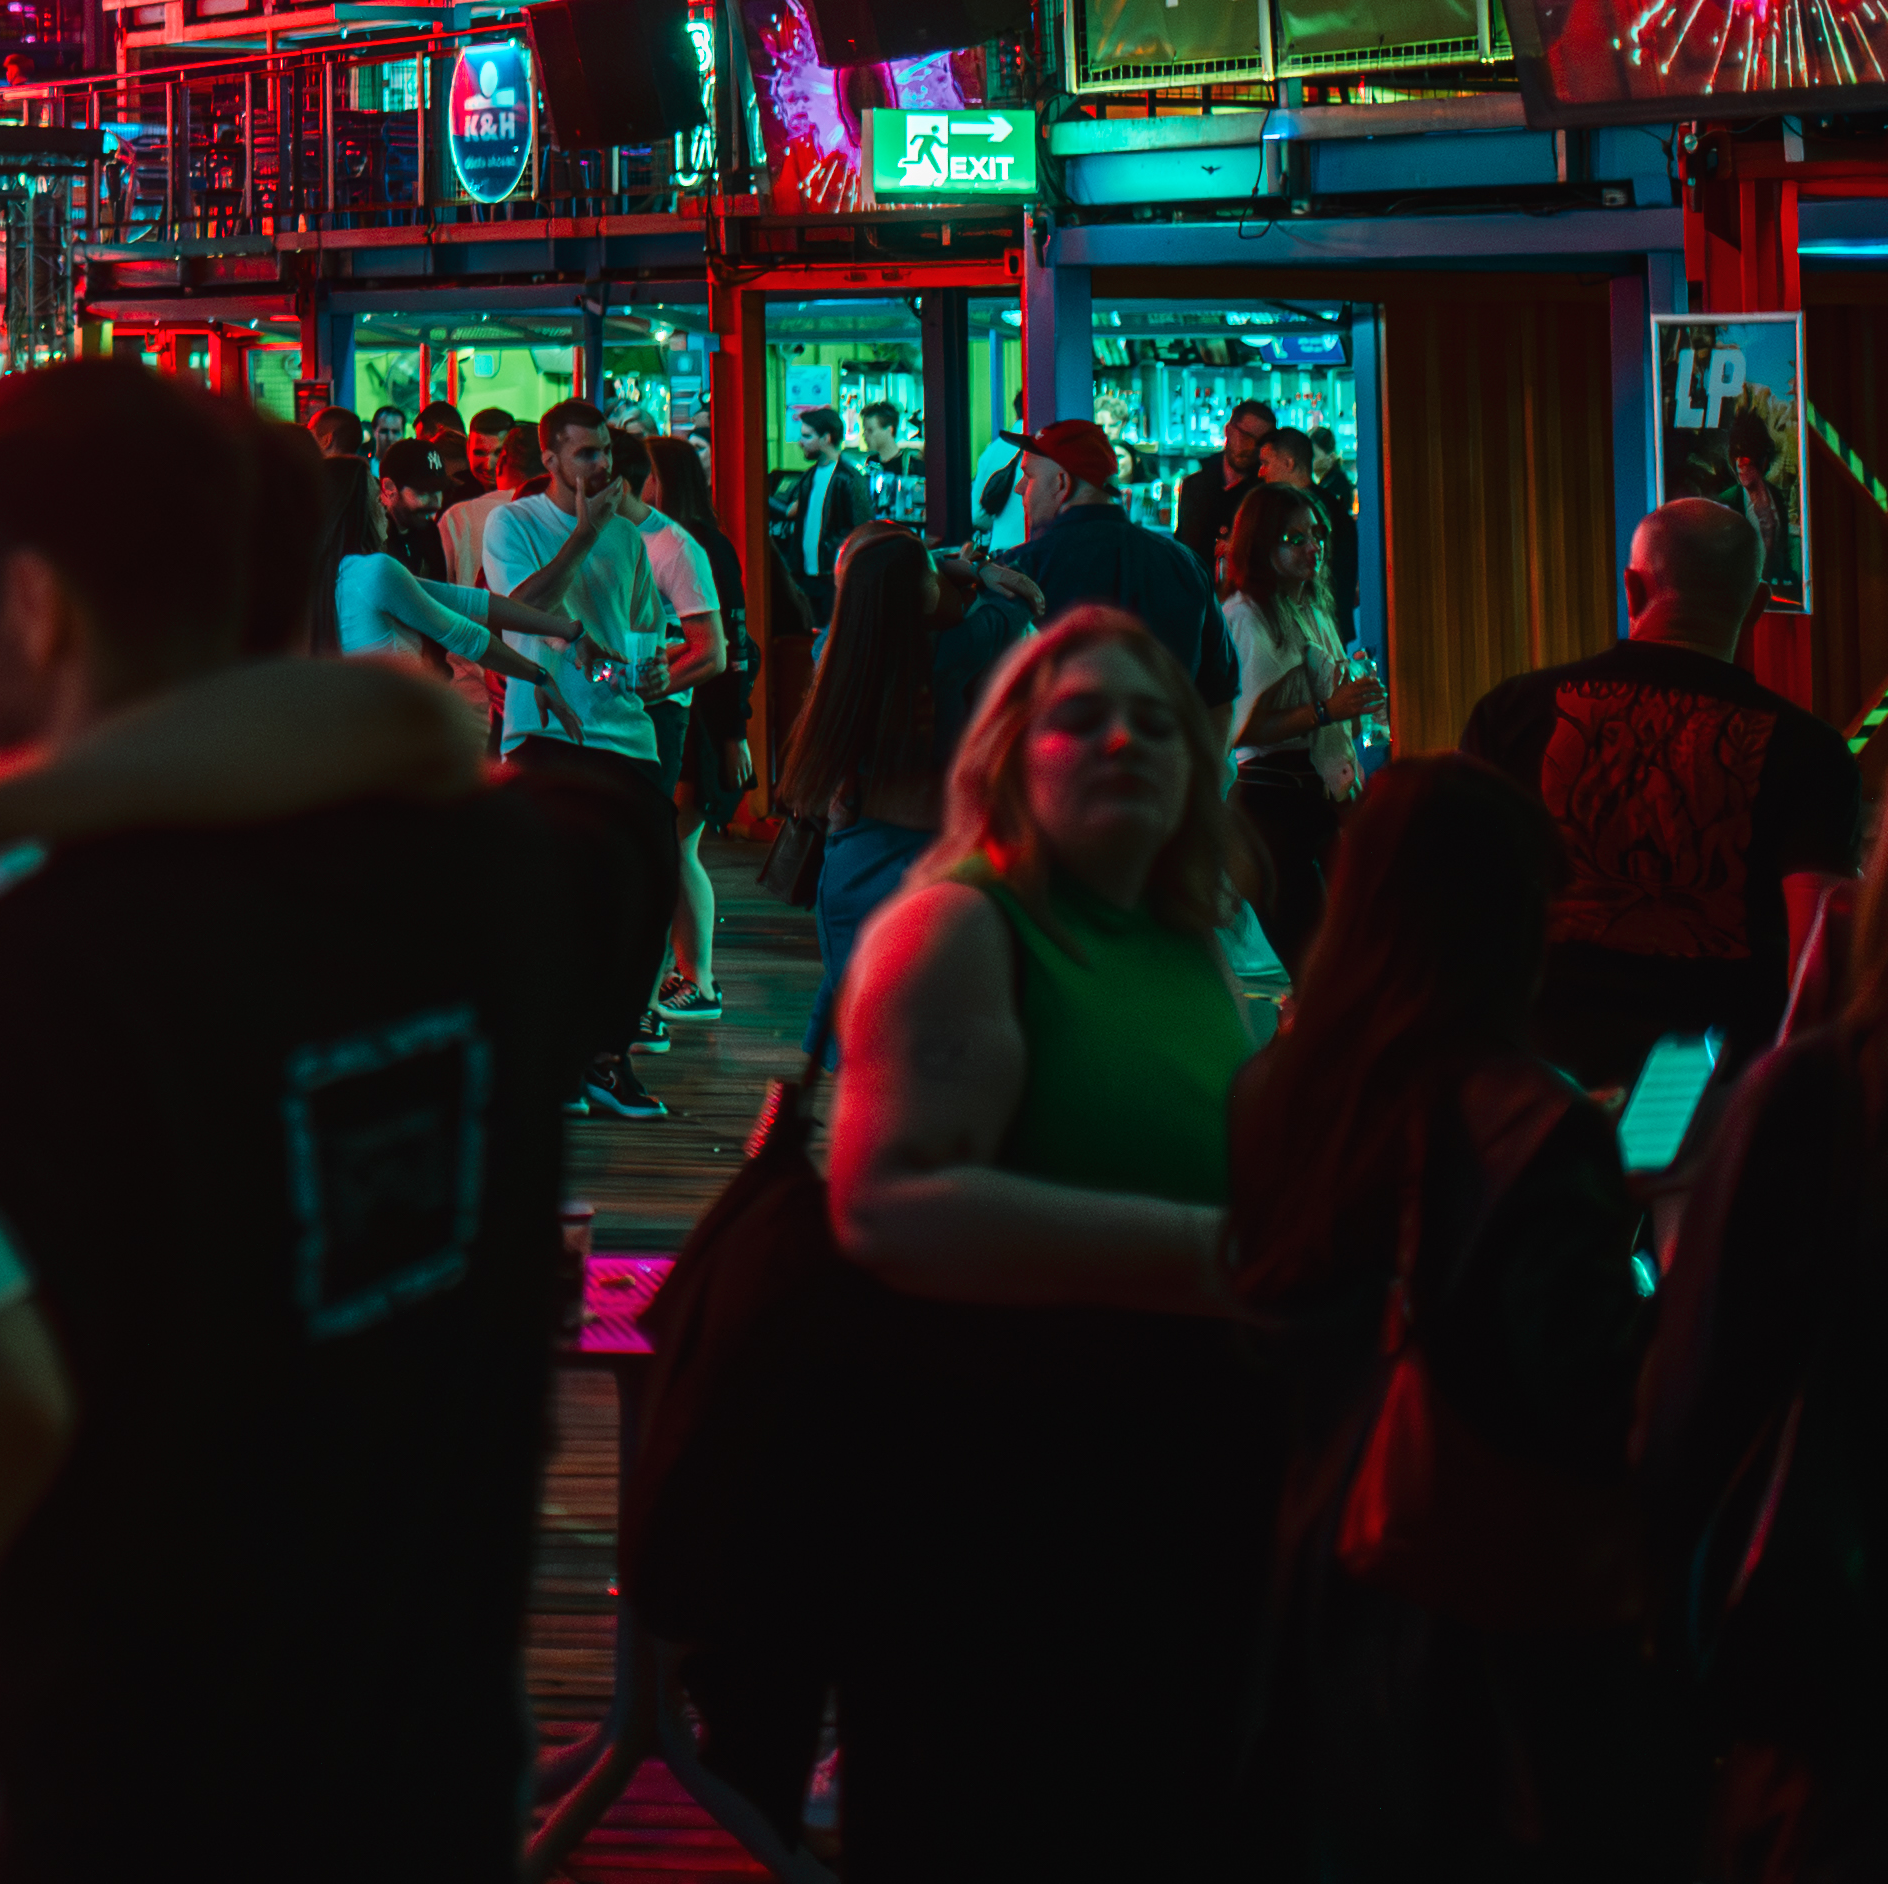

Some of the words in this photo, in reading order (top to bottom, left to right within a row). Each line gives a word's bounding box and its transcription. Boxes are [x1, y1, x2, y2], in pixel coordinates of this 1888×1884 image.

[464, 111, 515, 143] K&H
[950, 156, 1015, 180] EXIT
[1674, 348, 1746, 428] LP
